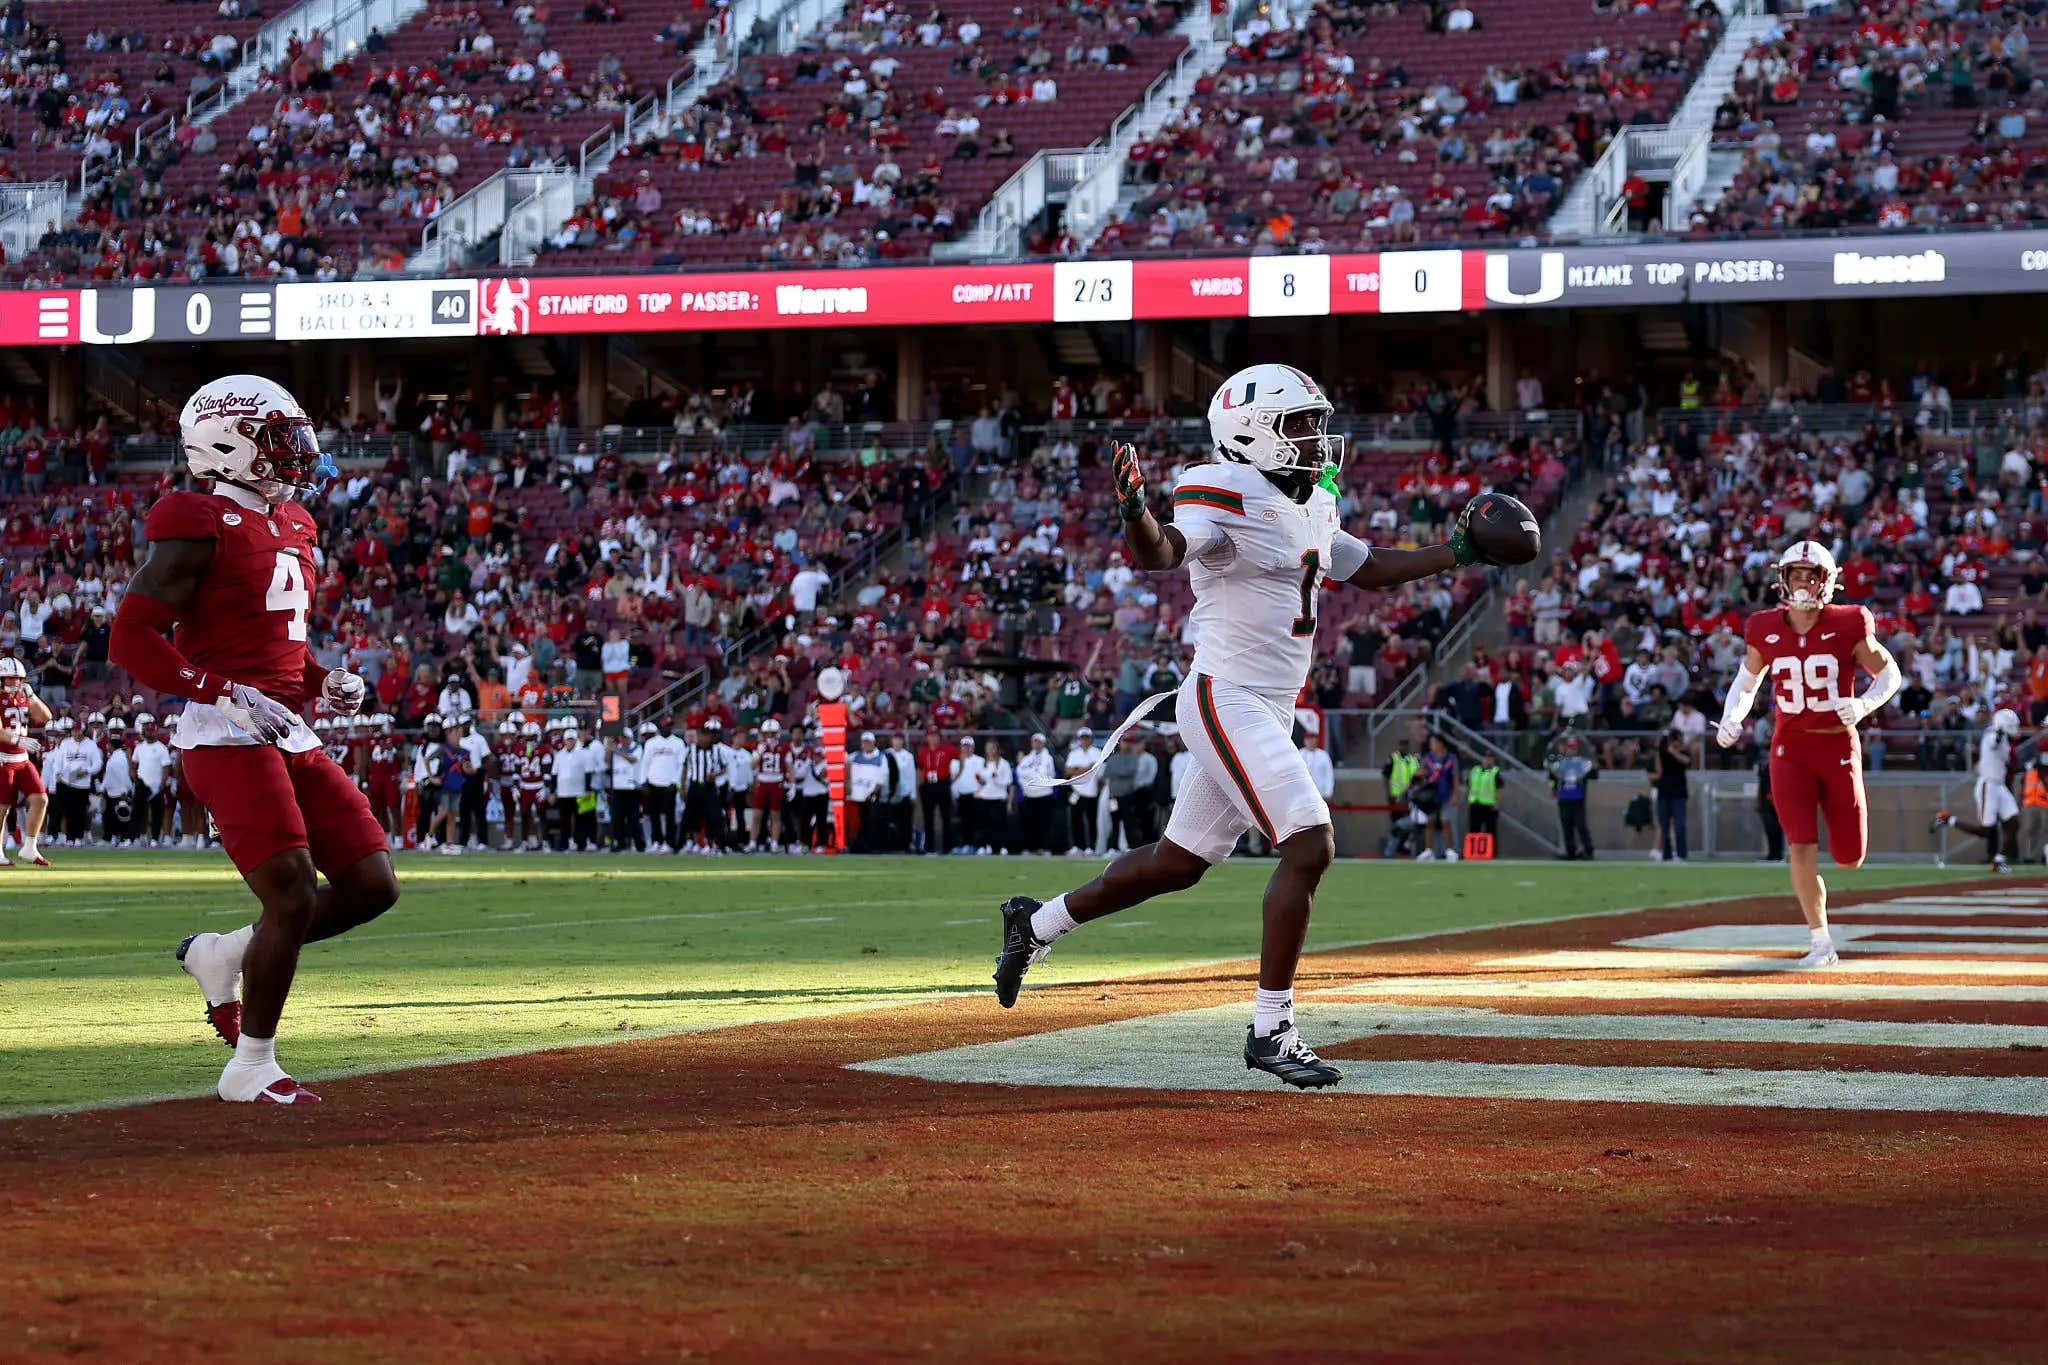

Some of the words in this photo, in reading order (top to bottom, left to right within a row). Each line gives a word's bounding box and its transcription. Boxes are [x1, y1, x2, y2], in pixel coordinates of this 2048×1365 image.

[2021, 250, 2048, 270] CO
[1283, 273, 1295, 297] 8
[1346, 272, 1380, 292] TDS
[1415, 270, 1427, 293] 0
[1568, 265, 1633, 287] MIAMI
[1645, 263, 1685, 285] TOP
[1695, 260, 1785, 283] PASSER:
[952, 282, 1033, 303] COMP/ATT
[1074, 278, 1113, 302] 2/3
[1190, 277, 1243, 296] YARDS
[318, 293, 354, 309] 3RD
[436, 295, 466, 319] 40
[538, 293, 628, 316] STANFORD
[638, 292, 672, 314] TOP
[680, 290, 760, 312] PASSER:
[186, 292, 212, 335] 0
[300, 315, 350, 332] BALL
[359, 314, 387, 330] ON
[193, 392, 268, 418] Stanford
[266, 550, 309, 641] 4
[1291, 547, 1321, 637] 1
[1771, 654, 1840, 714] 39
[1469, 836, 1488, 853] 10
